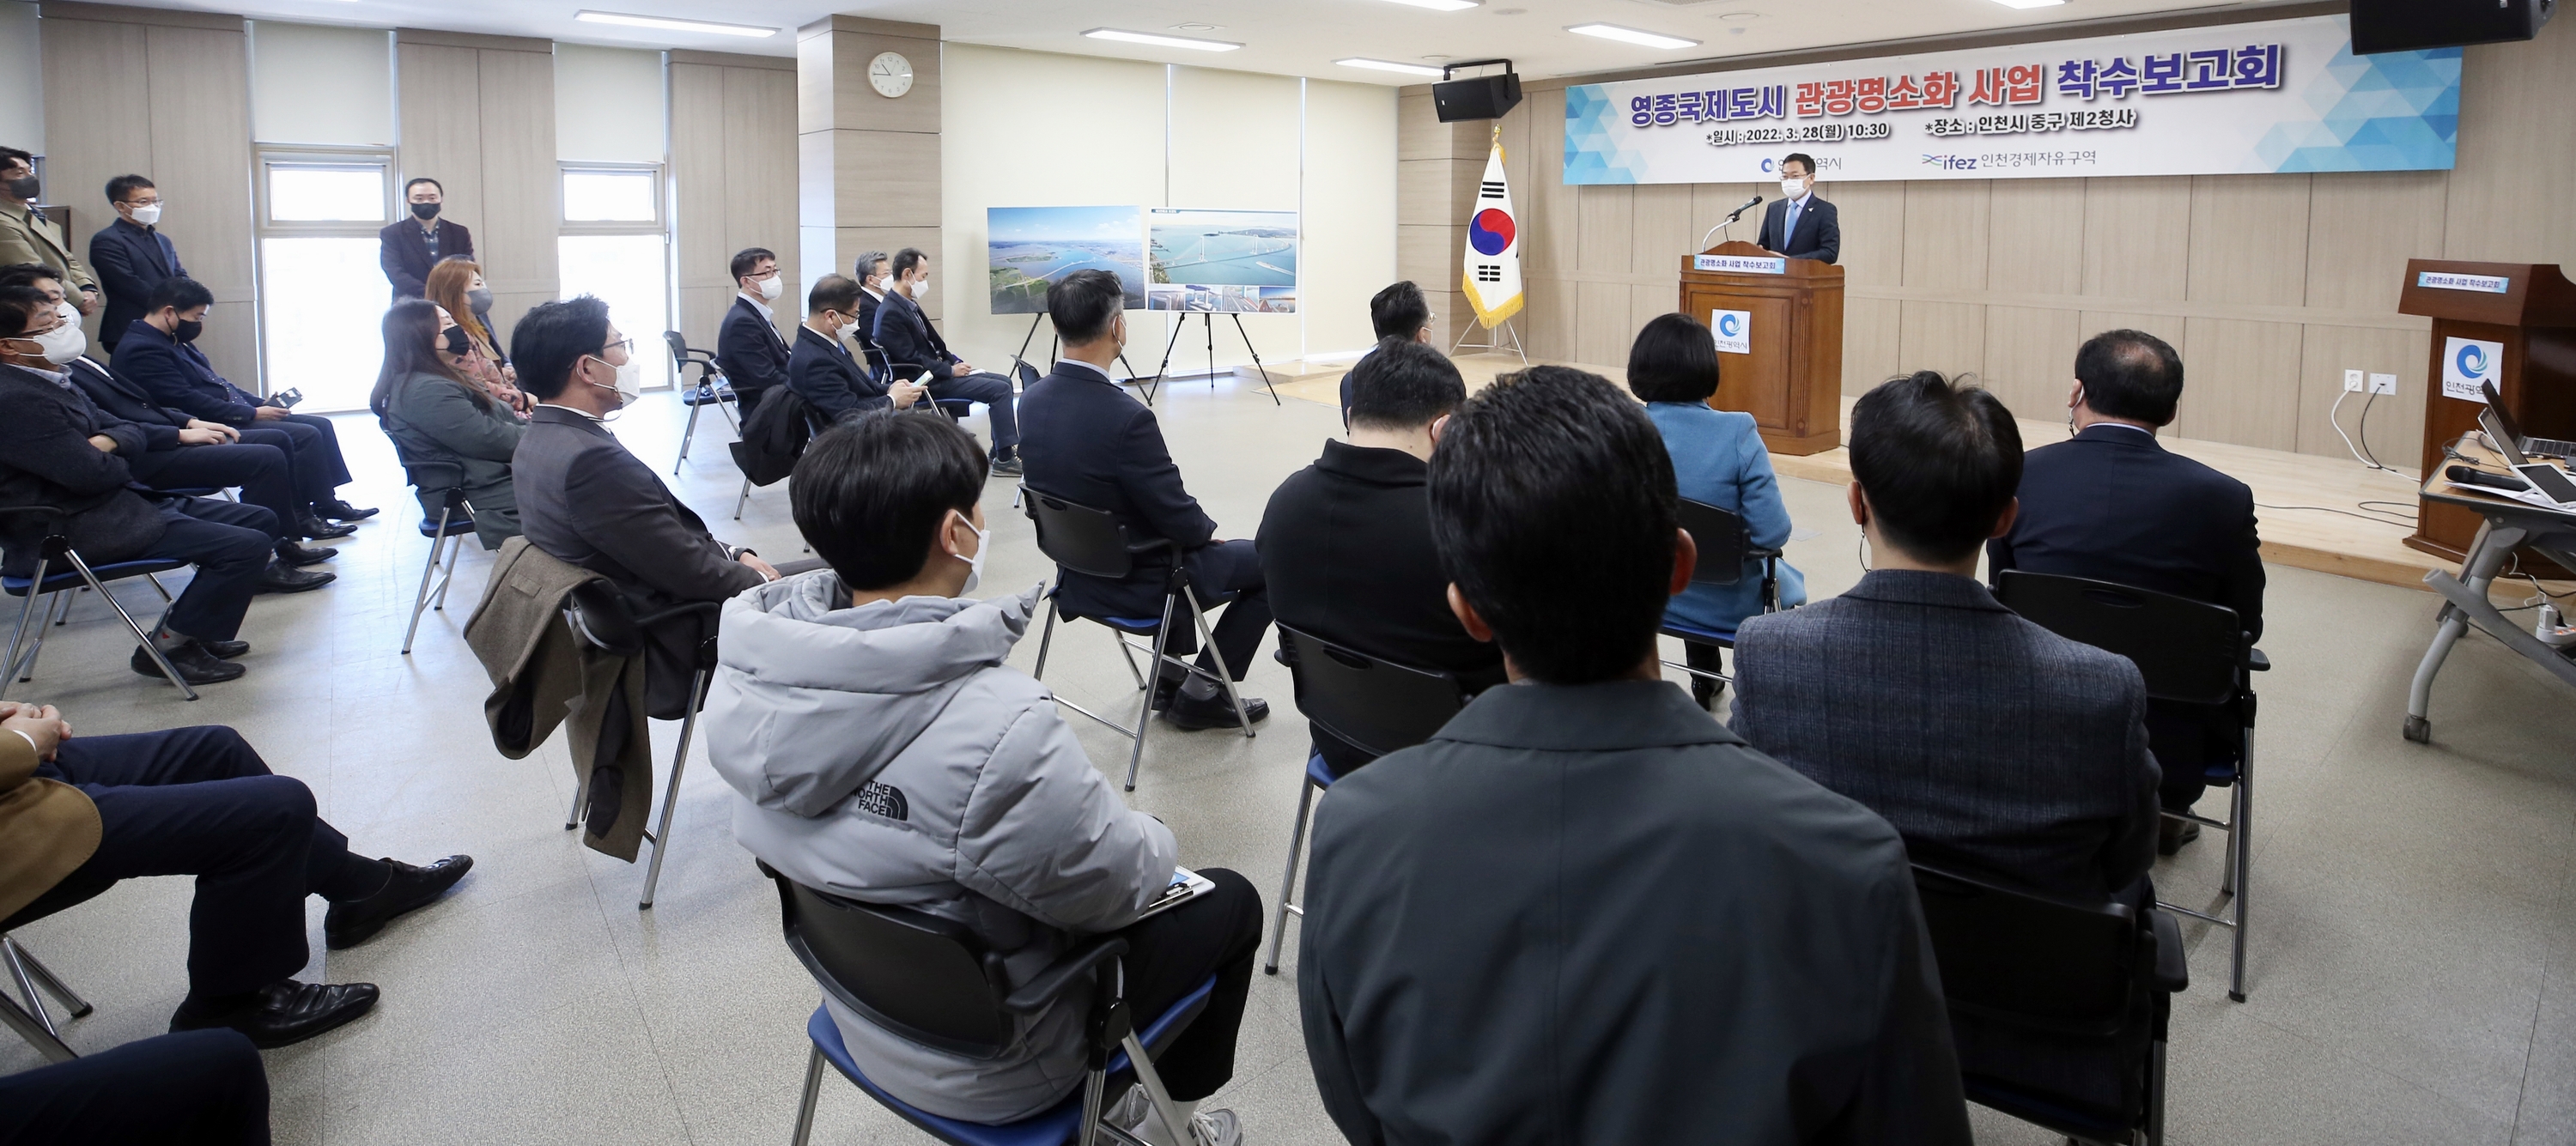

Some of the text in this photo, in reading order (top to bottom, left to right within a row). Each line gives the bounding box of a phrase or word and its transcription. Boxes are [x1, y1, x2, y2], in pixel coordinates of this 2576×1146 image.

[1630, 44, 2279, 125] 영종국제도시 관광명소화 사업 착수보고회
[1978, 114, 2025, 131] 인천시
[2031, 112, 2063, 130] 중구
[2069, 108, 2135, 127] 제2청사
[1746, 129, 1782, 142] 2022.
[1785, 128, 1799, 139] 3.
[1802, 124, 1843, 139] 28(월)
[1847, 122, 1888, 136] 10:30
[1943, 155, 1978, 170] ifez
[1981, 149, 2097, 168] 인천경제자유구역
[1700, 258, 1776, 270] 관광명소화 사업 착수보고회
[868, 779, 890, 796] THE
[858, 798, 886, 816] FACE
